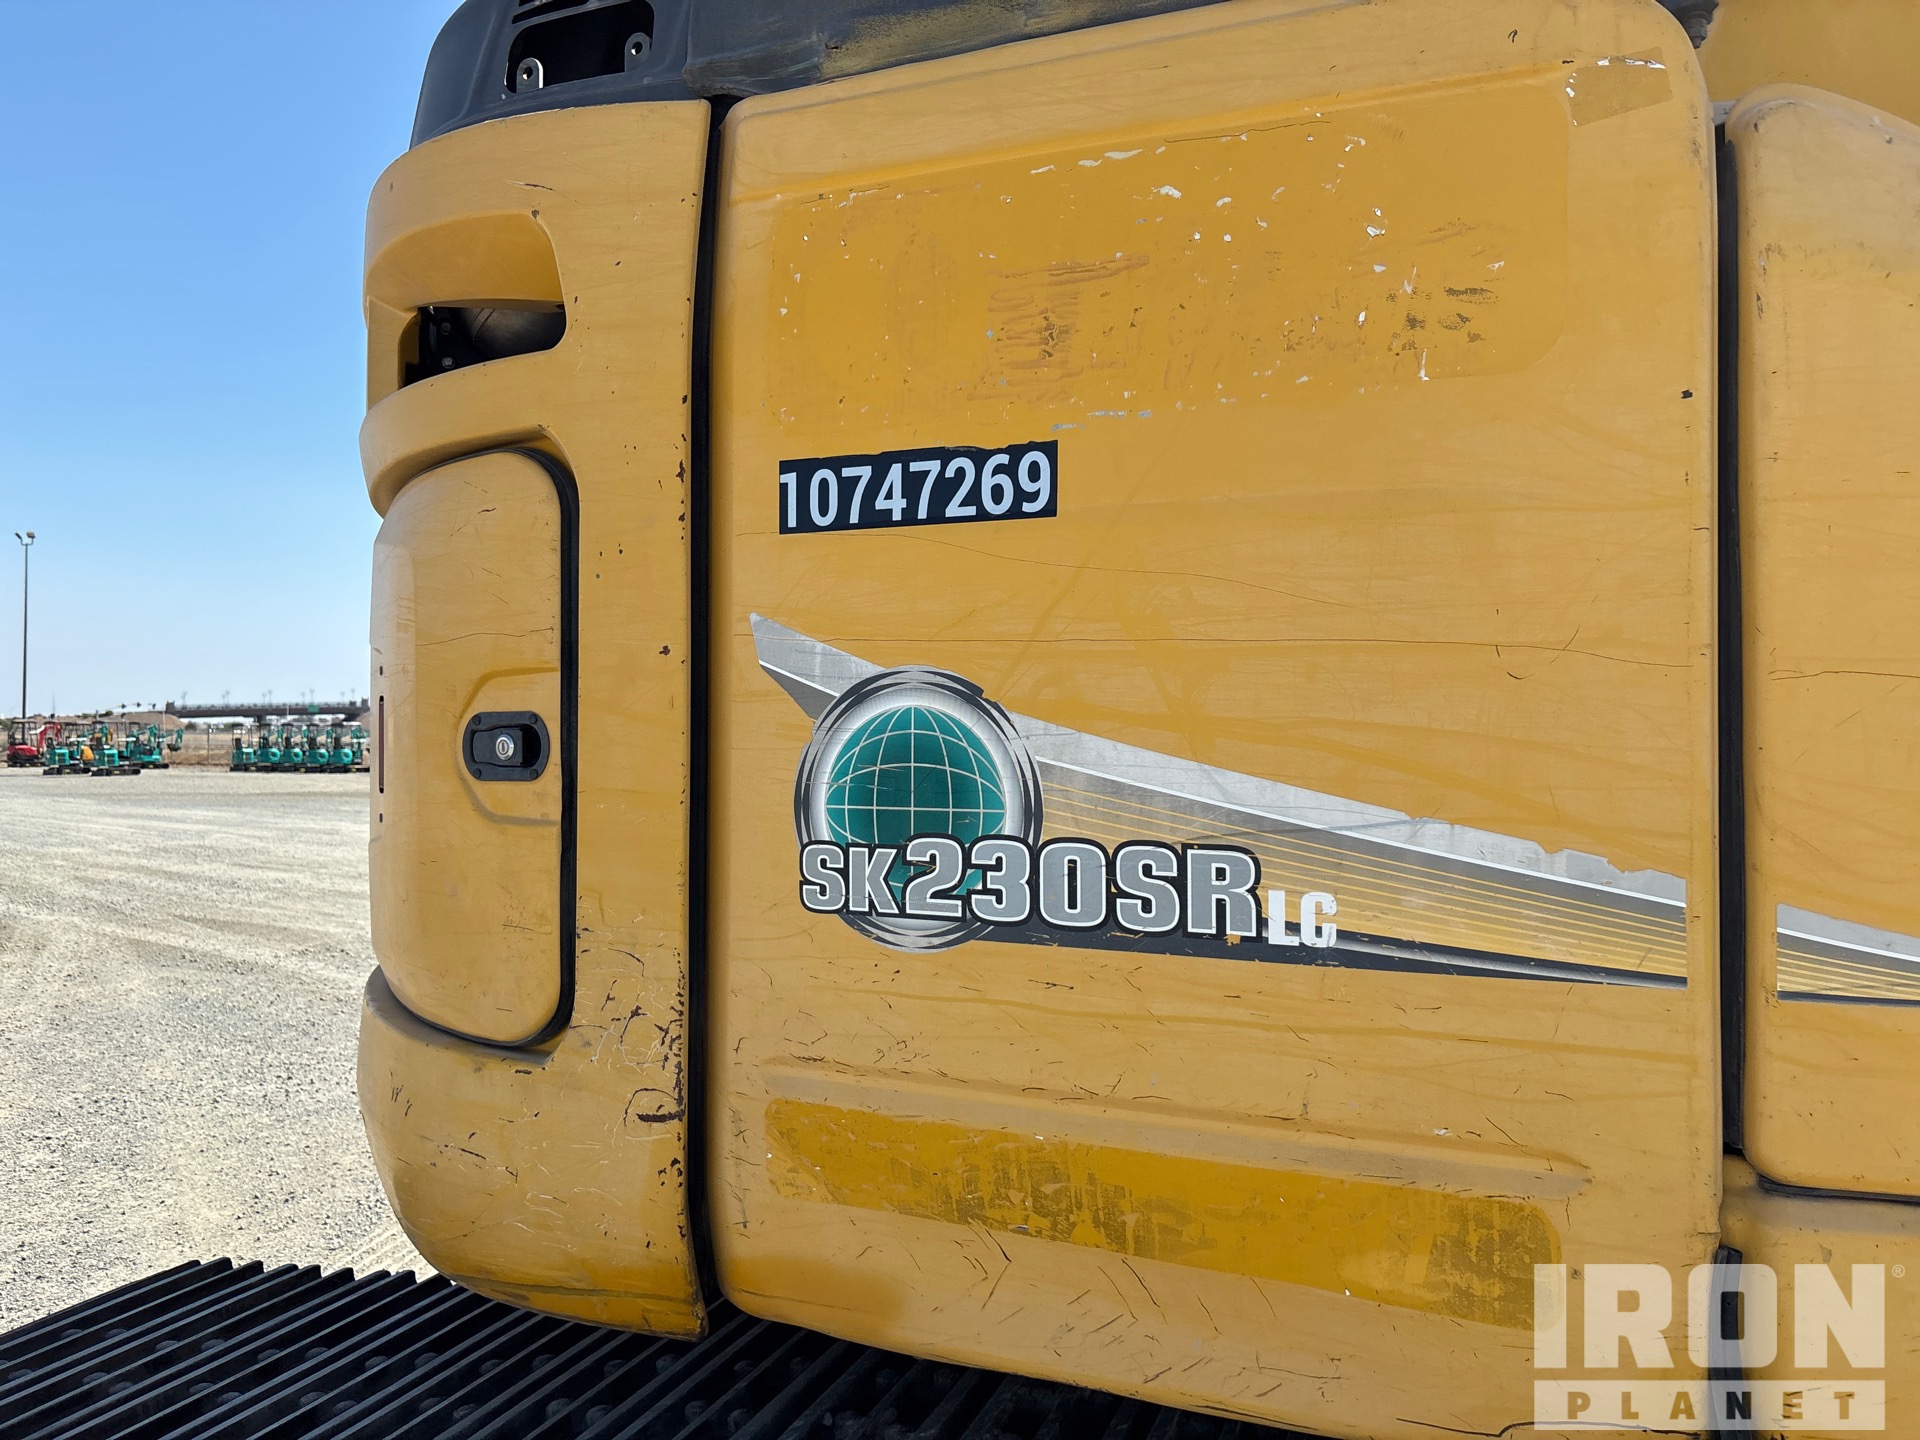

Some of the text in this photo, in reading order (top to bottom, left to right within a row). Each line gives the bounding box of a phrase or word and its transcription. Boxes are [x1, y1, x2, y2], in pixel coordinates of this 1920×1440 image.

[780, 450, 1051, 528] 10747269
[801, 835, 1338, 948] SK230SR LC
